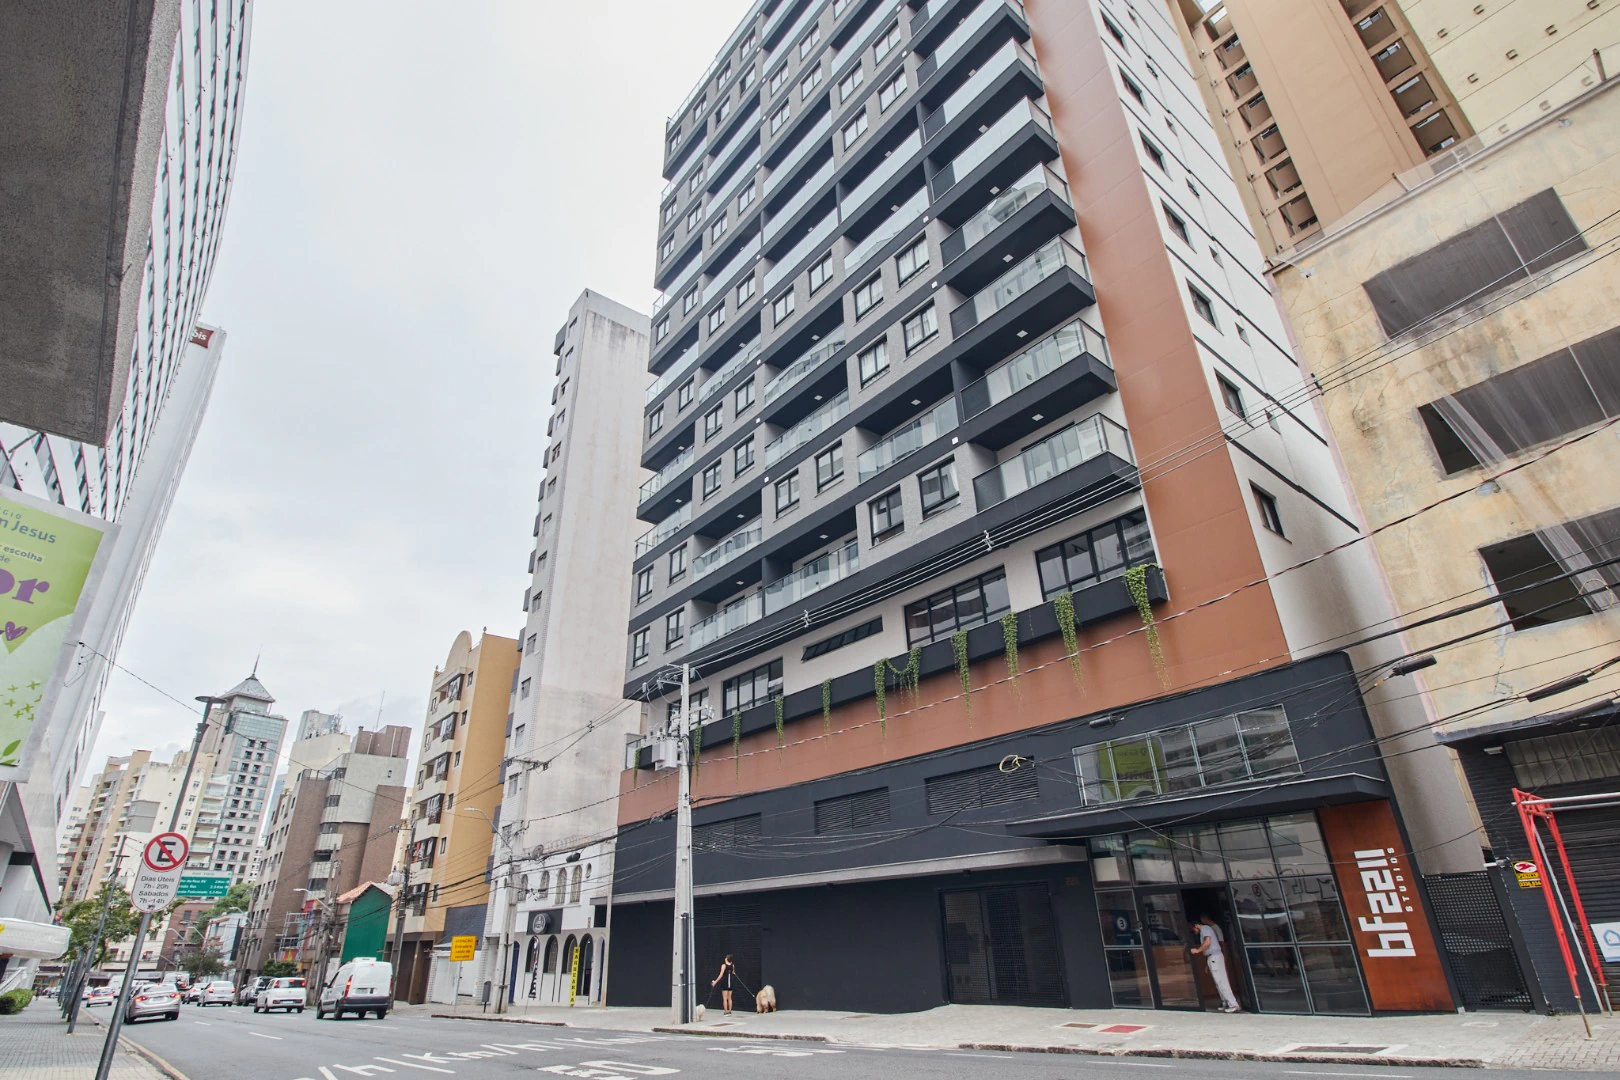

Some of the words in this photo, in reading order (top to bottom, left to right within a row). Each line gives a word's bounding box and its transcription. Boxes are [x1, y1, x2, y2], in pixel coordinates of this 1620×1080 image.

[11, 520, 57, 544] Jesus
[3, 546, 43, 562] escolha
[1386, 847, 1414, 913] STUDIOS
[570, 948, 579, 1003] BARBEARIA
